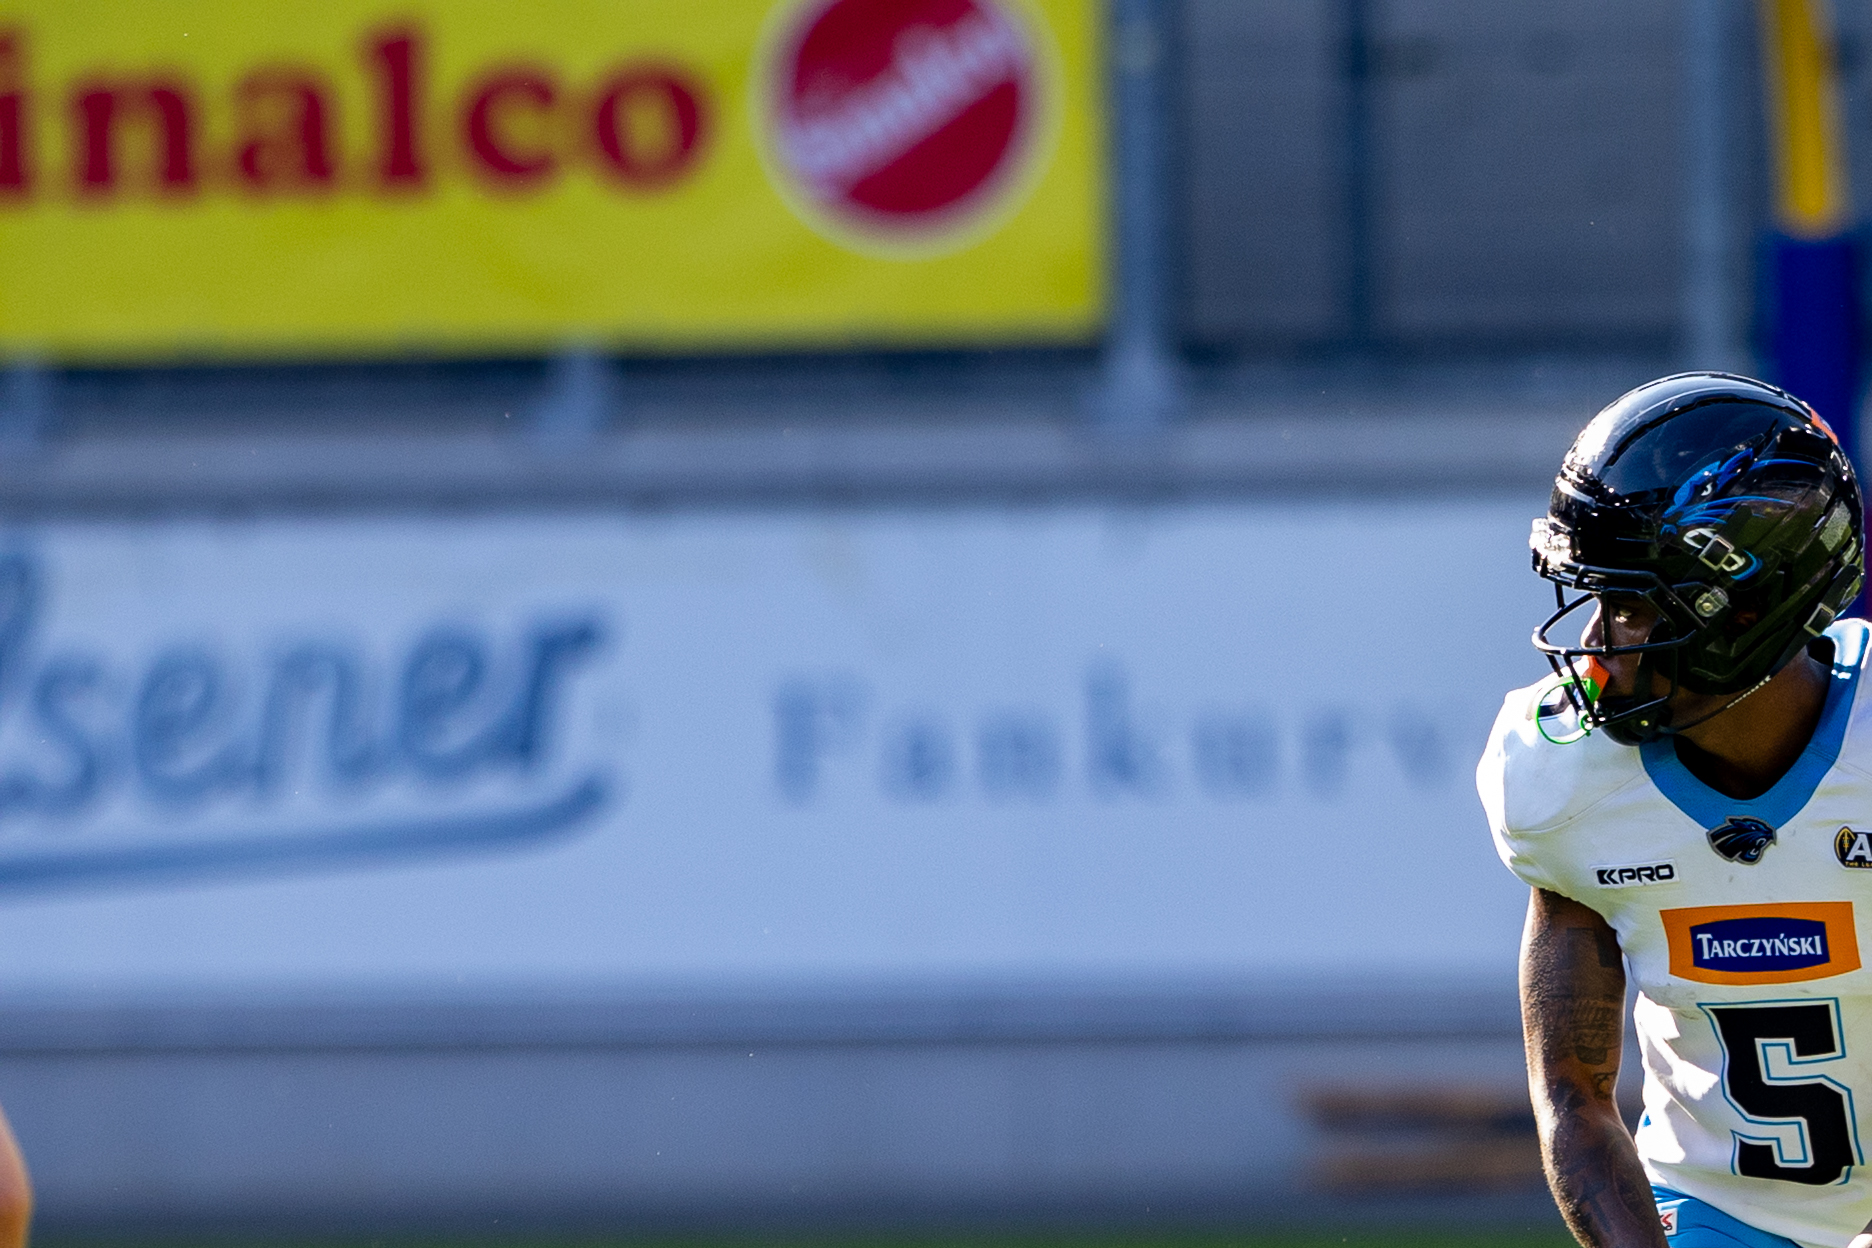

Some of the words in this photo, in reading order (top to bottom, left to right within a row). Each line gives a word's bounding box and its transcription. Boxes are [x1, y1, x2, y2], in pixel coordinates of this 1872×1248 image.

[766, 650, 1456, 806] Fankurv
[1696, 933, 1823, 960] TARCZYŃSKI
[1696, 997, 1864, 1186] 5
